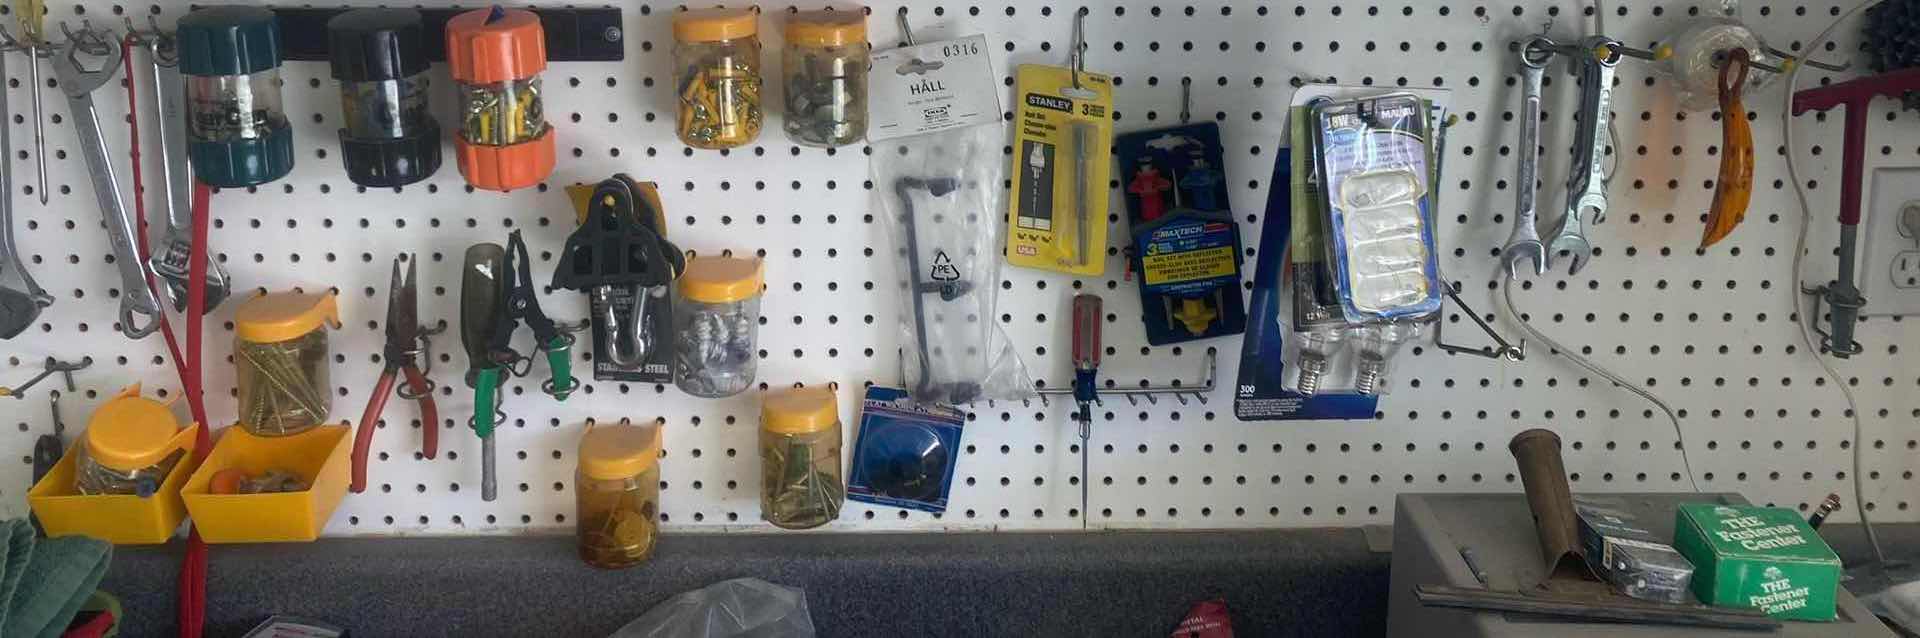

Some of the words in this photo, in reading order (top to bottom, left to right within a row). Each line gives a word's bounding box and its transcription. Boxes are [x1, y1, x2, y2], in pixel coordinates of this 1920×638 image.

[943, 42, 978, 58] 0316
[909, 79, 946, 95] HÅLL
[1028, 95, 1072, 112] STANLEY
[1081, 103, 1089, 116] 3
[1146, 242, 1158, 255] 3
[938, 264, 951, 274] PE
[644, 364, 669, 374] STEEL
[1240, 385, 1255, 394] 300
[1721, 515, 1766, 530] THE
[1716, 524, 1800, 542] Fastener
[1741, 535, 1807, 550] Center
[1760, 578, 1791, 593] THE
[1751, 587, 1809, 607] Fastener
